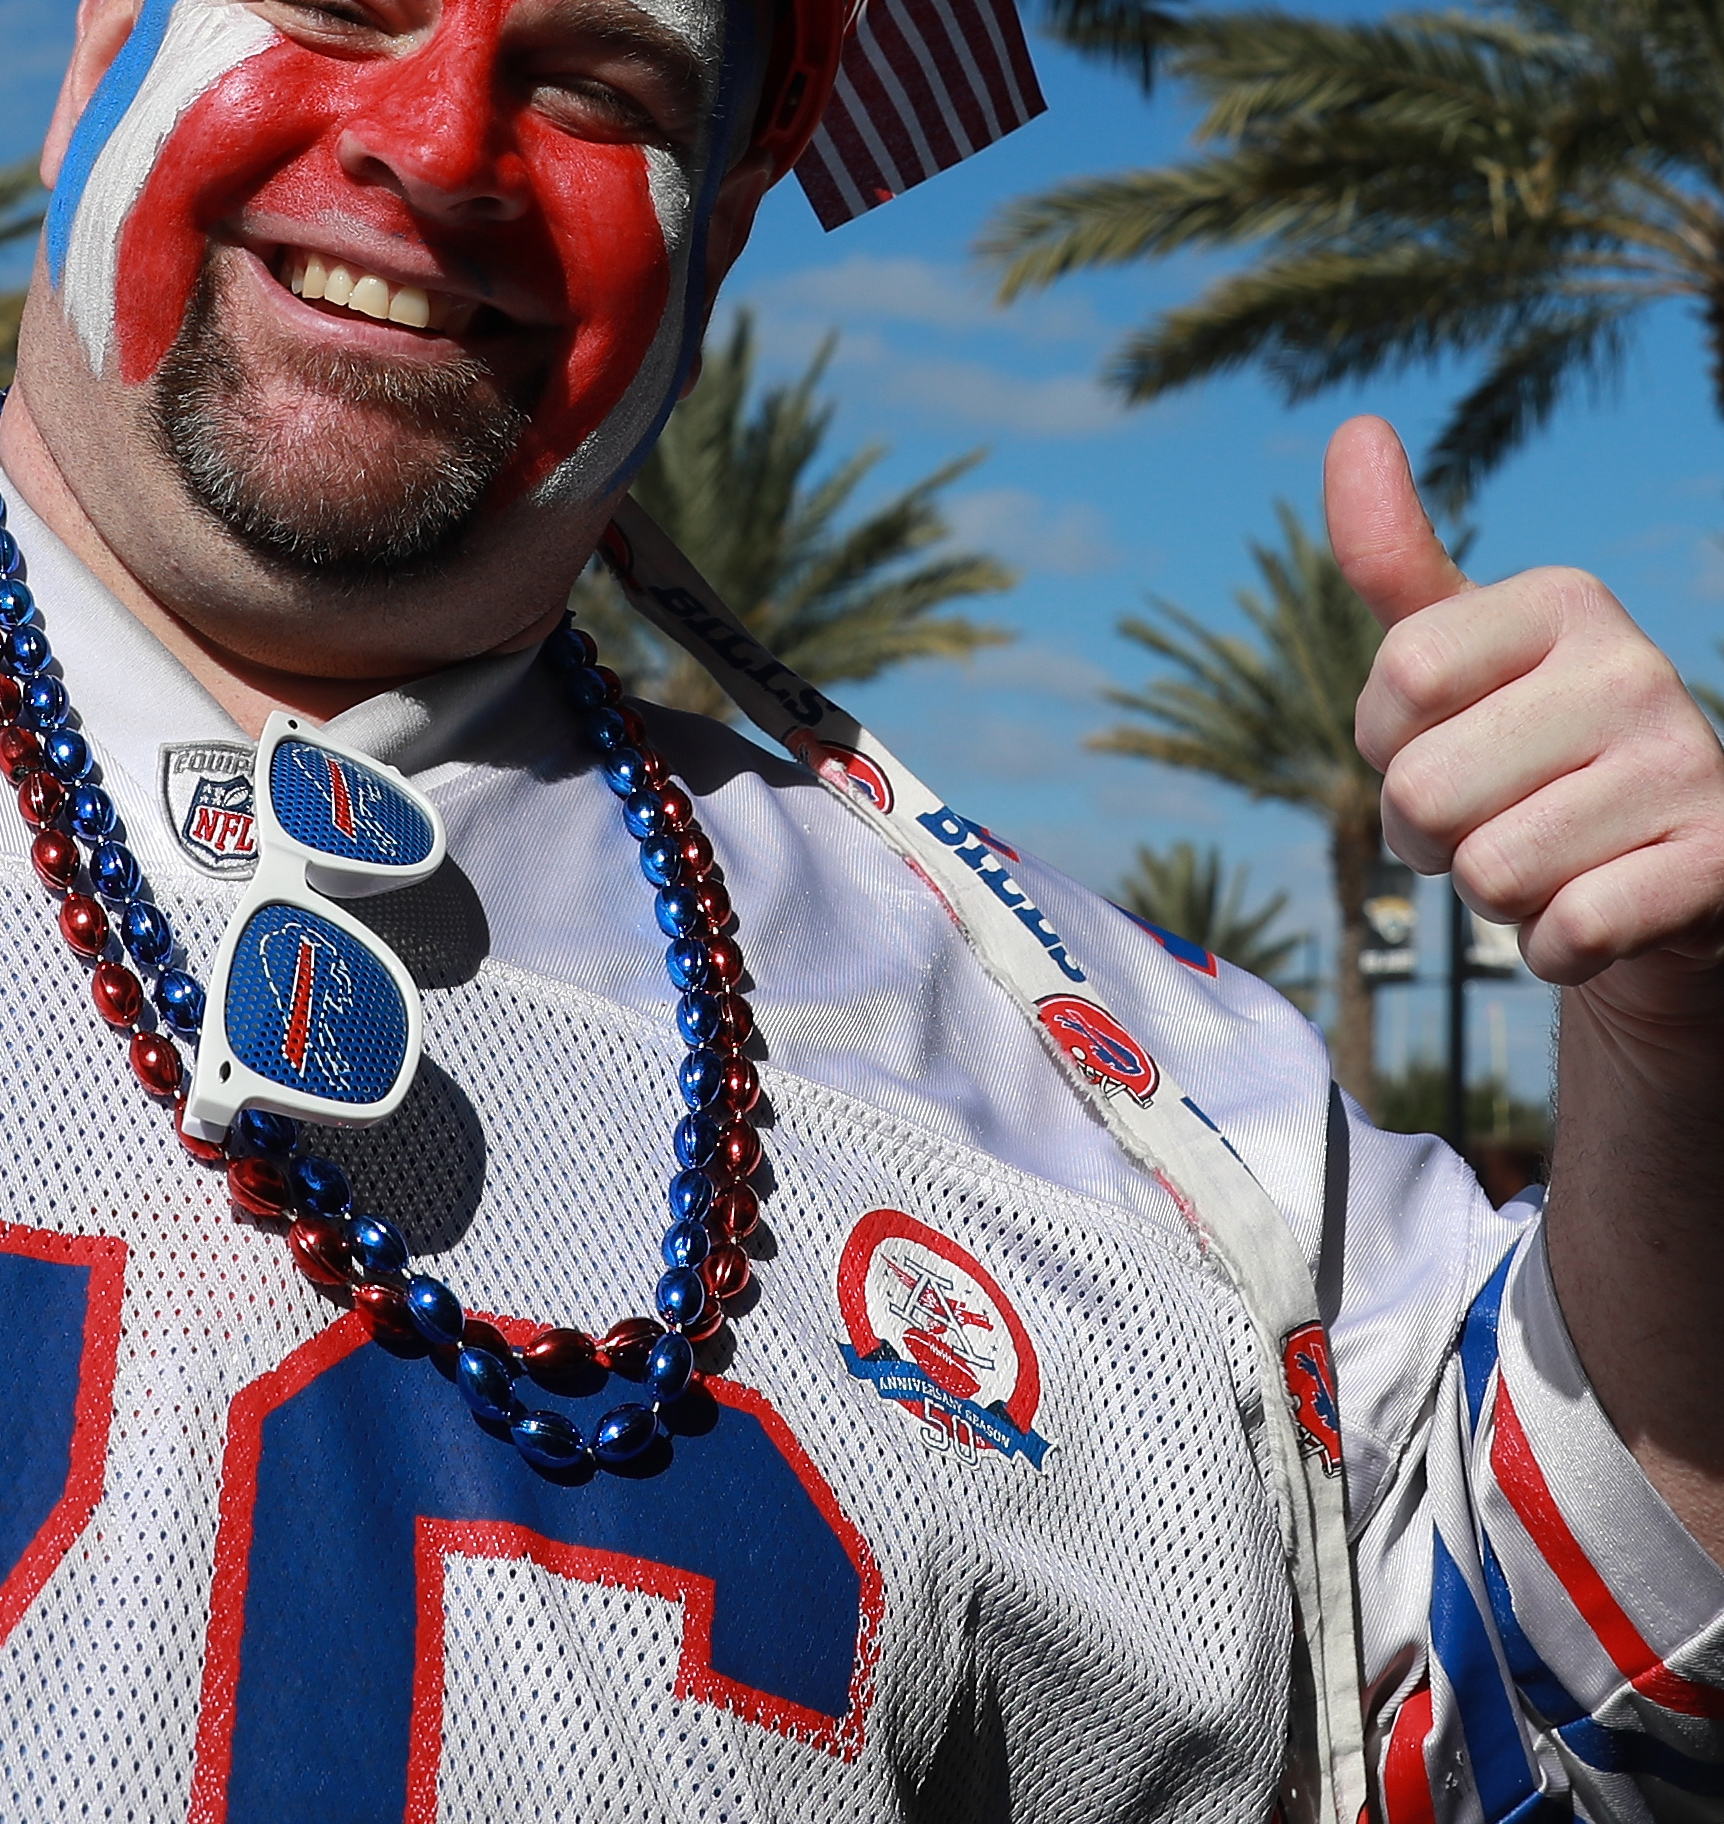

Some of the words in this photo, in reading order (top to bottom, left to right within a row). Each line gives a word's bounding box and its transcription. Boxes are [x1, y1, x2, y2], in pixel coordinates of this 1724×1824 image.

[648, 585, 841, 726] BILLS
[192, 807, 254, 852] NFL
[879, 1374, 963, 1415] ANNIVERSARY
[965, 1408, 1011, 1449] SEASON
[919, 1396, 978, 1467] 50
